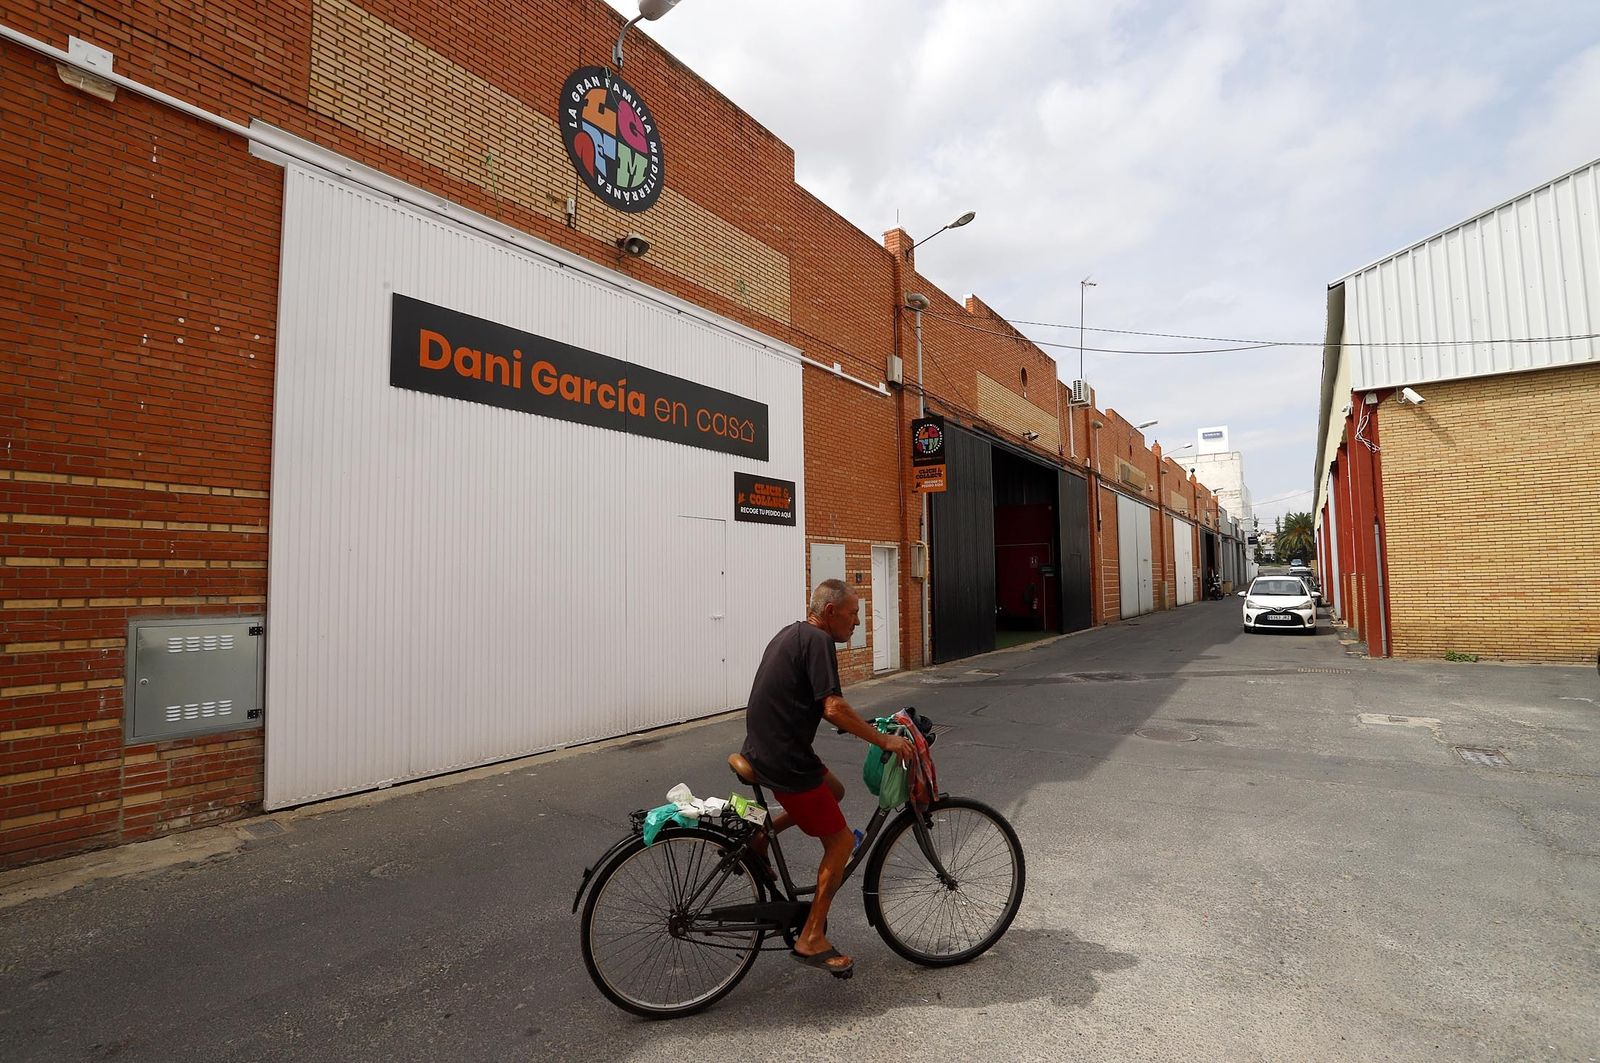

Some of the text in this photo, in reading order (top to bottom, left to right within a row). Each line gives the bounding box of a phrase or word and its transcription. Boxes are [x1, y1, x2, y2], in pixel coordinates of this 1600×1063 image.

[571, 76, 601, 102] GRAN
[568, 108, 578, 128] LA
[605, 77, 652, 134] FAMILIA
[419, 328, 521, 389] Dani
[531, 359, 646, 417] García
[653, 396, 688, 427] en
[766, 509, 780, 517] PEDIDO
